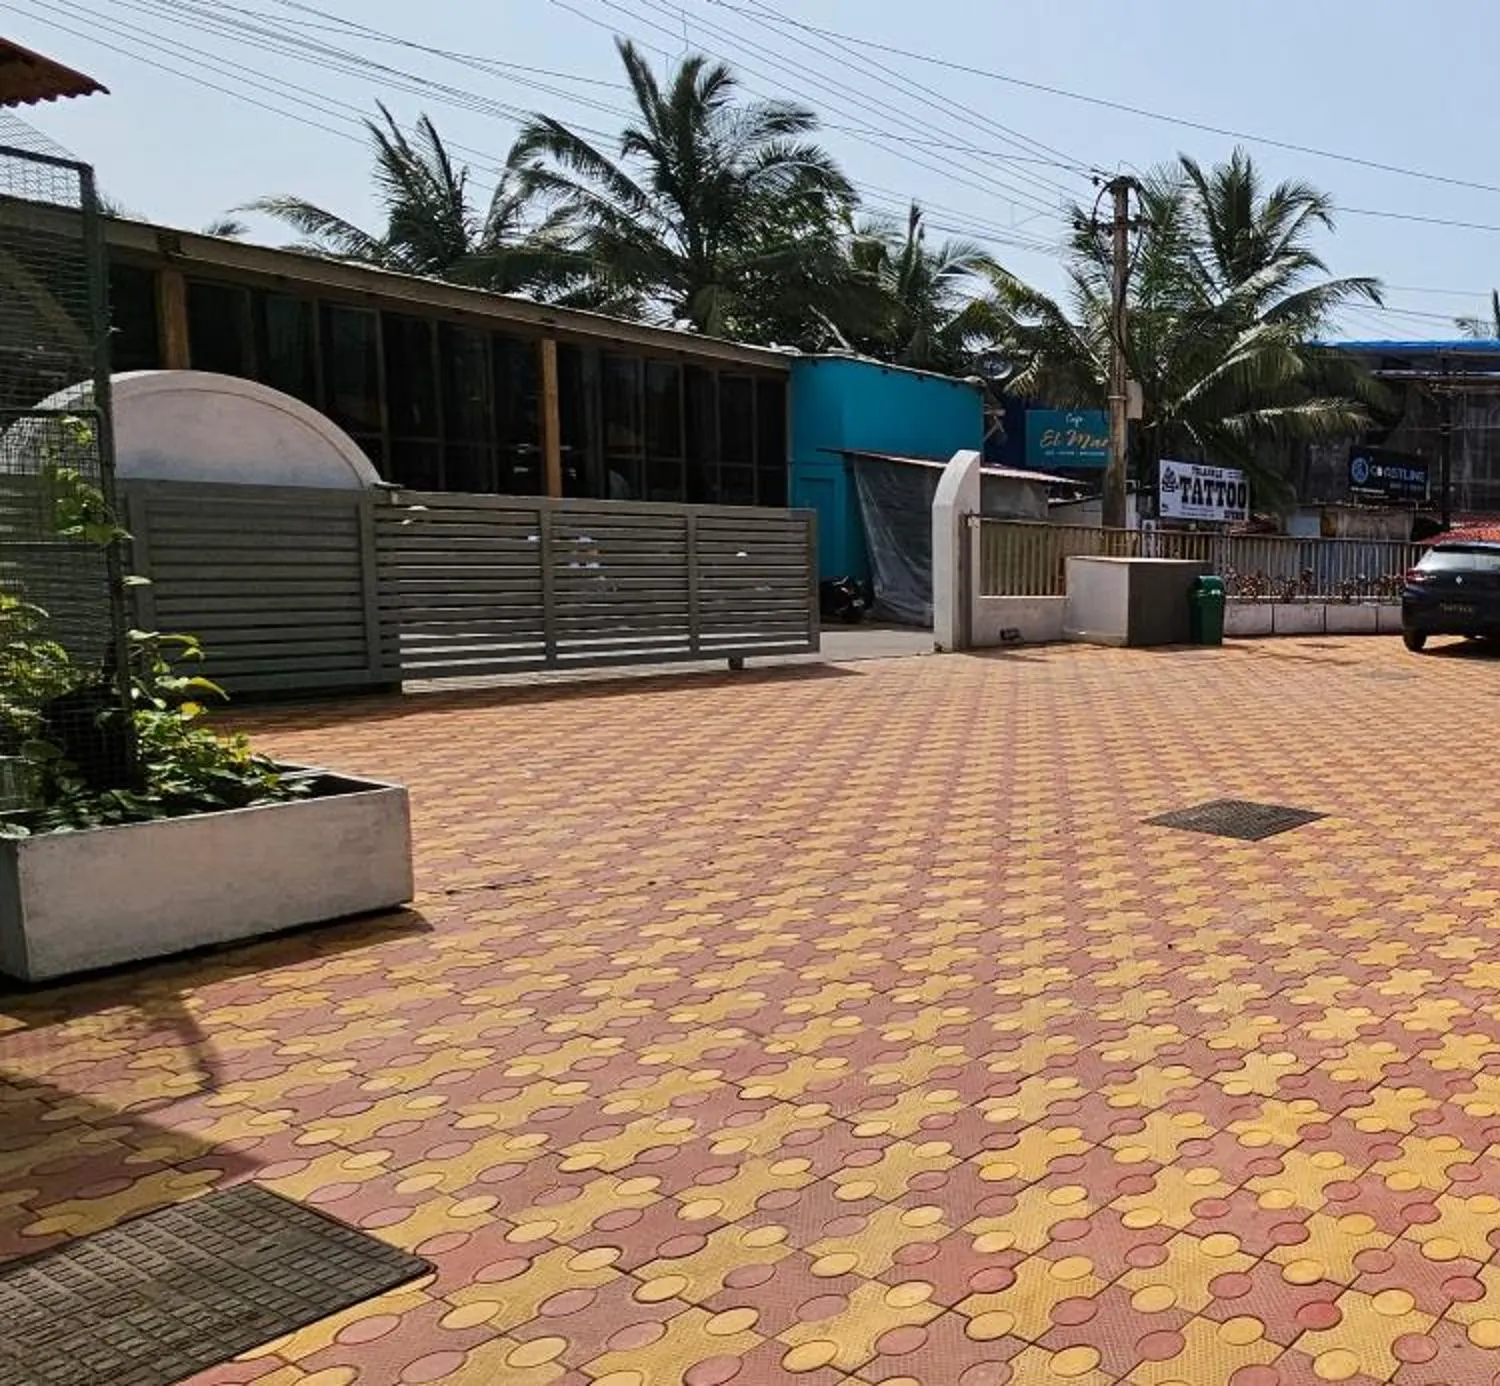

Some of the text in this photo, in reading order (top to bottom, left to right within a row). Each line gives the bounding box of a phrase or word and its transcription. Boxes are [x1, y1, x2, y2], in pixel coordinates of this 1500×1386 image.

[1040, 429, 1060, 448] El
[1370, 465, 1425, 483] CASTLINE
[1179, 476, 1247, 508] TATTOO
